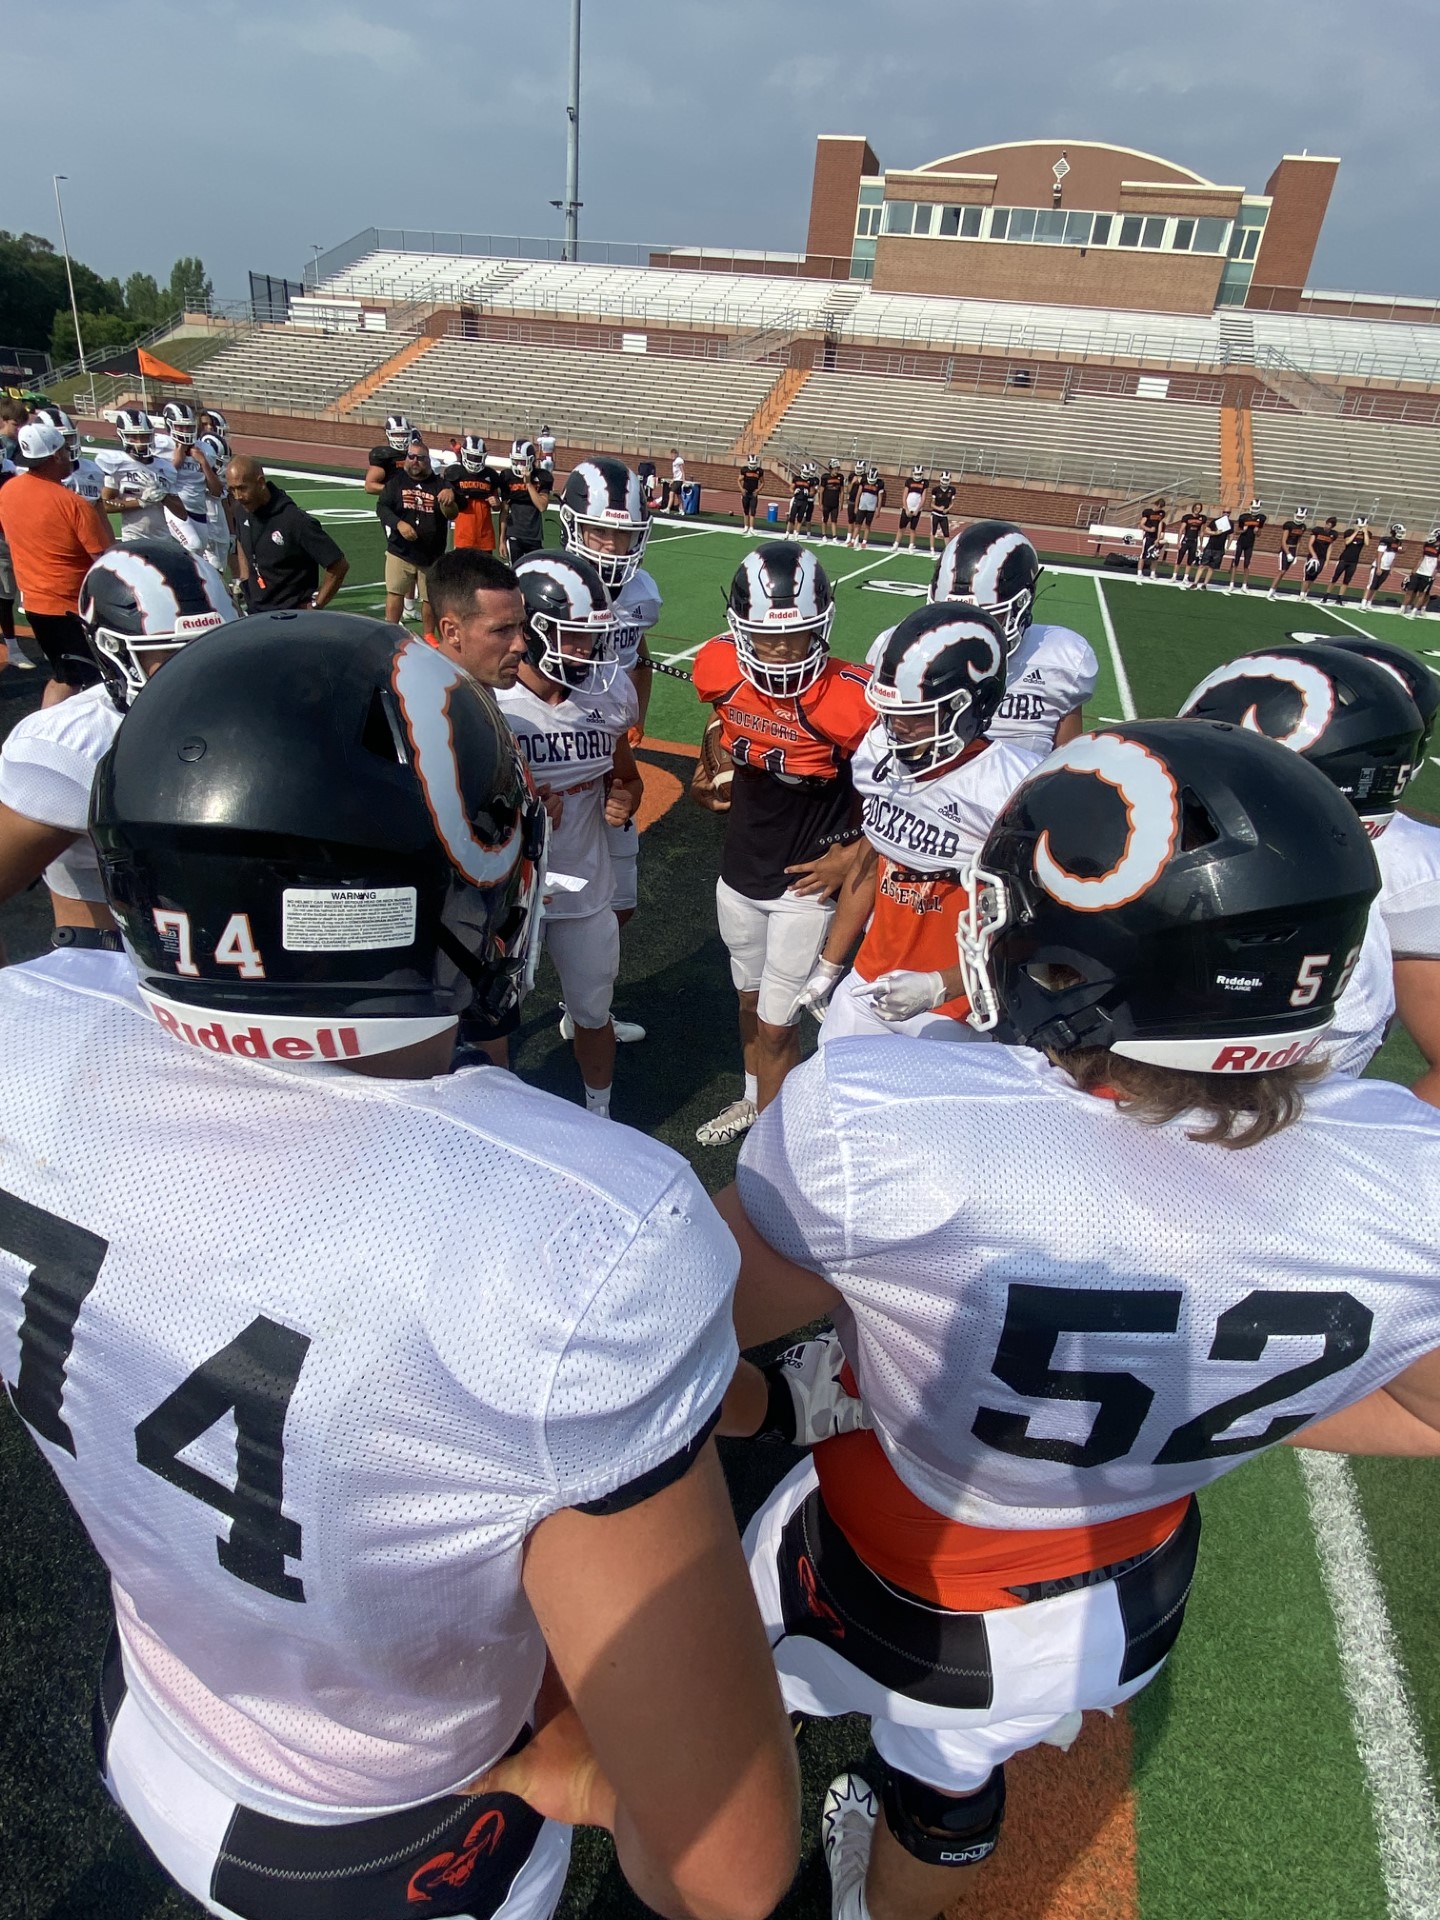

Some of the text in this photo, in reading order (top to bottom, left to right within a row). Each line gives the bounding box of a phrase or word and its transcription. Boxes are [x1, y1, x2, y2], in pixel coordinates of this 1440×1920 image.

[605, 511, 629, 520] Riddell
[182, 617, 222, 629] Riddell
[768, 611, 798, 619] Riddell
[1023, 677, 1046, 686] adidas
[728, 707, 800, 743] ROCKFORD
[517, 730, 613, 764] OCKFORD
[937, 807, 961, 824] adidas
[151, 907, 266, 979] 74
[150, 1001, 361, 1060] Riddell
[1211, 1034, 1324, 1071] Ridd
[971, 1283, 1375, 1468] 52
[0, 1187, 312, 1604] 74
